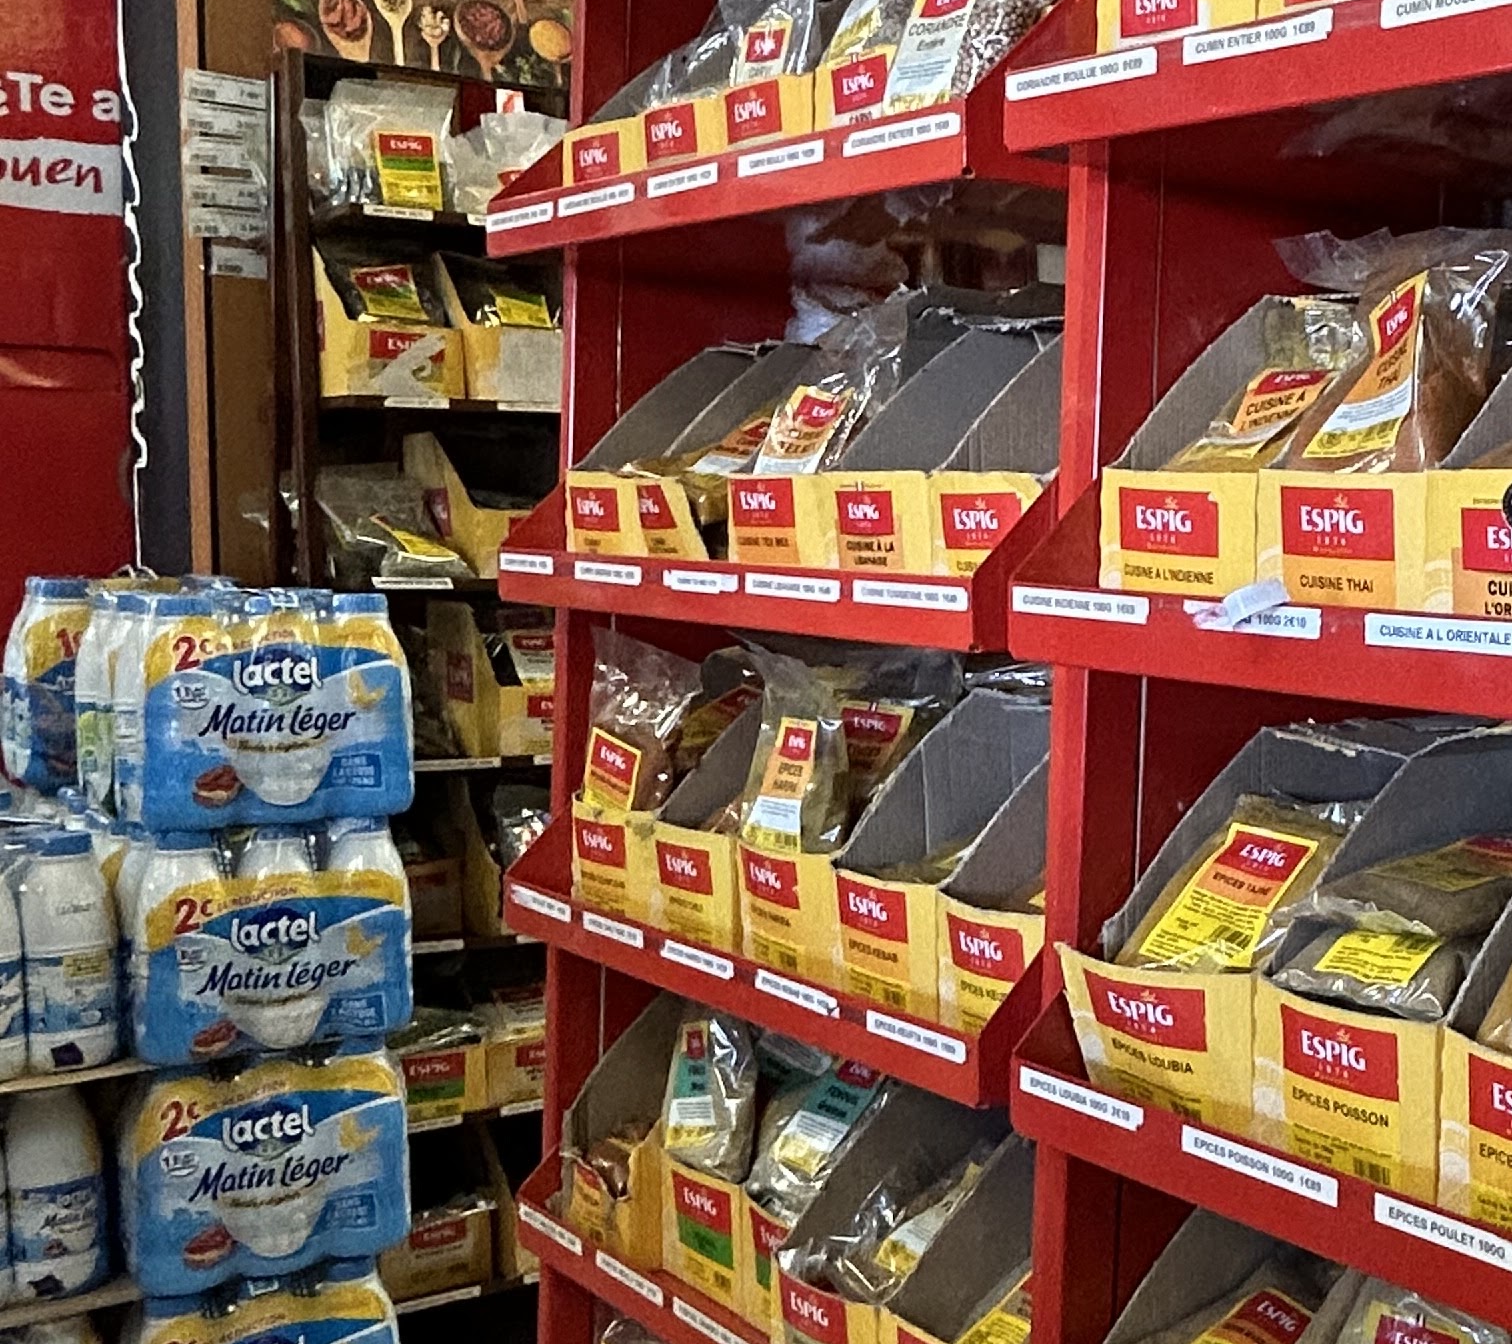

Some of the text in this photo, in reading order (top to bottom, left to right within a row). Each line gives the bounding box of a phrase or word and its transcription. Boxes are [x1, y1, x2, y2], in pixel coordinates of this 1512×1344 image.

[734, 99, 767, 123] ESPIG
[651, 121, 683, 147] ESPIG
[954, 508, 999, 531] ESPIG
[1136, 504, 1192, 534] ESPIG
[1300, 503, 1365, 535] ESPIG
[1300, 574, 1344, 594] CUISINE
[1379, 624, 1421, 642] CUISINE
[1446, 629, 1511, 647] ORIENTALE
[232, 656, 323, 694] lactel
[198, 702, 357, 740] Matin léger
[1239, 842, 1288, 869] ESPIG
[848, 891, 888, 923] ESPIG
[230, 910, 319, 949] lactel
[959, 932, 1004, 962] ESPIG
[196, 956, 357, 997] Matin léger
[1107, 989, 1174, 1028] ESPIG
[1301, 1029, 1366, 1072] ESPIG
[1291, 1086, 1389, 1129] EPICES POISSON
[221, 1104, 315, 1151] lactel
[188, 1152, 351, 1204] Matin léger
[1388, 1206, 1475, 1247] EPICES POULET
